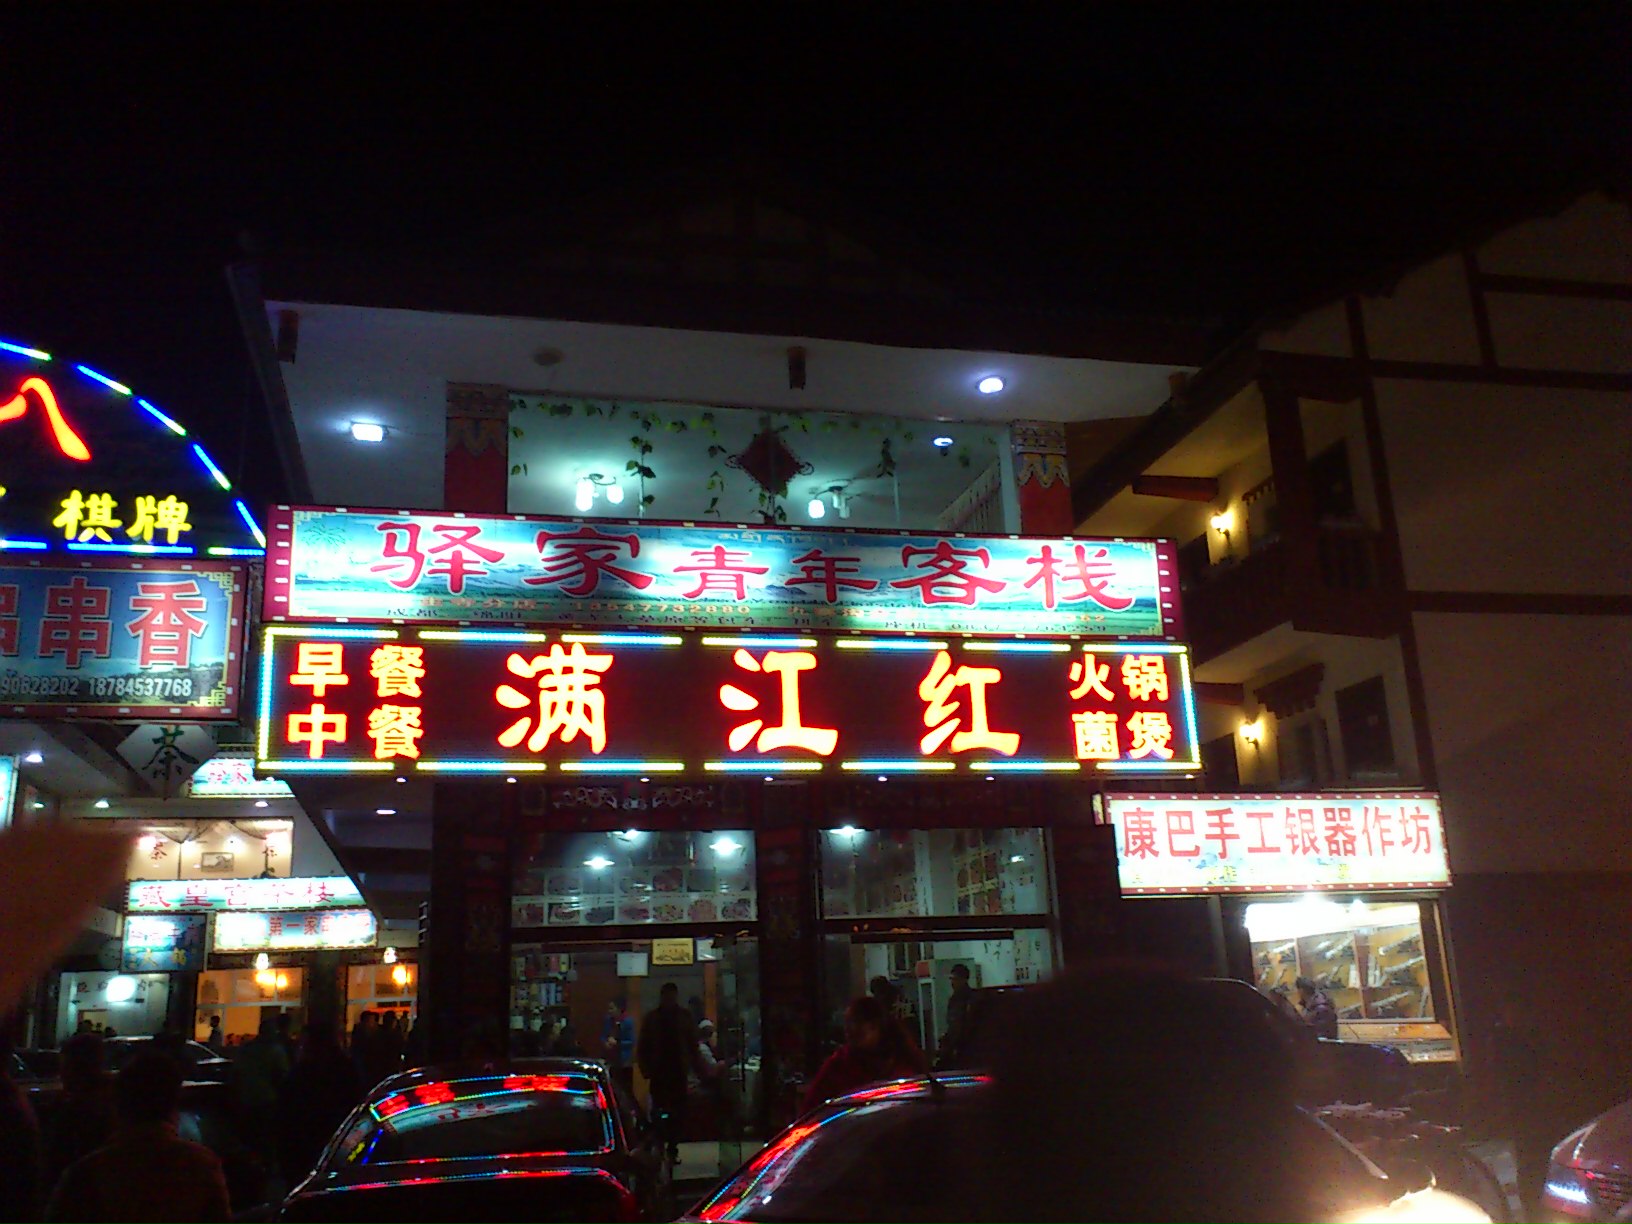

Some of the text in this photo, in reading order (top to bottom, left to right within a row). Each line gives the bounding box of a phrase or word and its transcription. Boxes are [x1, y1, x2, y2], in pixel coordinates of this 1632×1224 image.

[52, 489, 193, 544] 棋牌
[370, 521, 1136, 611] 驿家青年客栈
[0, 576, 207, 670] 串香
[88, 677, 193, 698] 18784537768
[288, 642, 426, 699] 早餐
[1068, 652, 1169, 703] 火锅
[495, 641, 1022, 757] 满江红
[287, 703, 425, 760] 中餐
[1072, 710, 1175, 761] 菌煲
[1122, 806, 1433, 860] 康巴手工银器作坊
